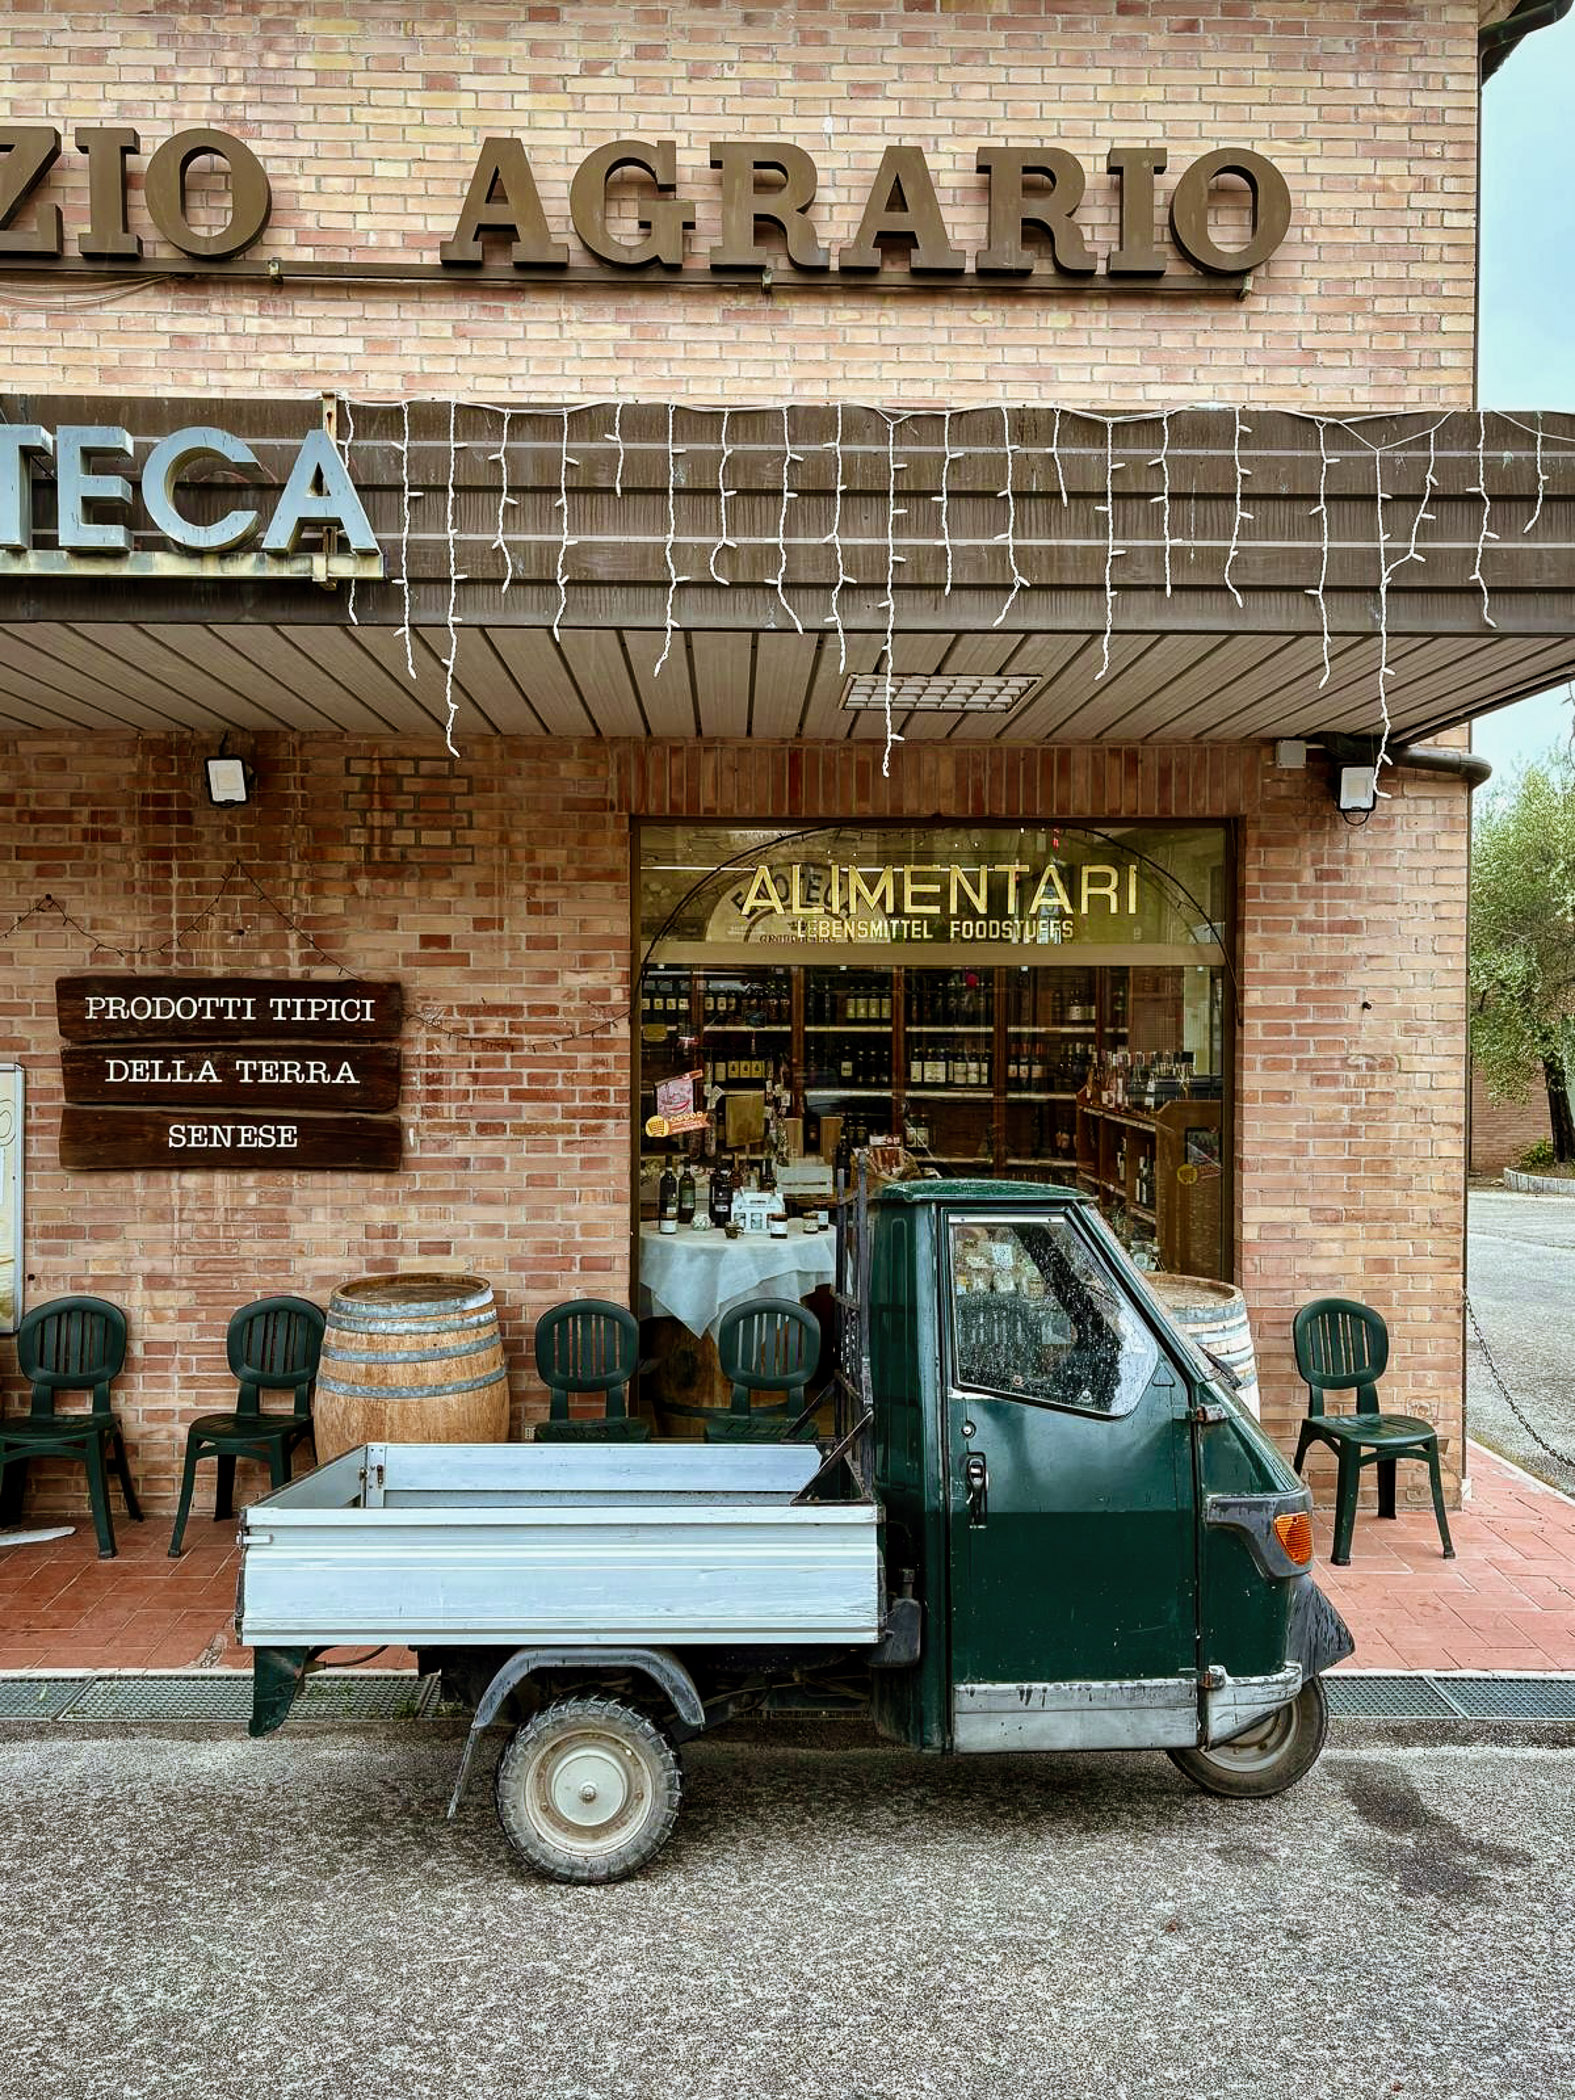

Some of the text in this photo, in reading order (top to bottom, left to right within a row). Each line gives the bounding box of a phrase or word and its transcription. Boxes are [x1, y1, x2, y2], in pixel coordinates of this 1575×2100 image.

[0, 127, 1292, 274] ZIO AGRARIO
[740, 863, 1138, 916] ALIMENTARI
[797, 919, 934, 940] LEBENSMITTEL
[949, 919, 1075, 940] FOODSTUFFS
[84, 996, 375, 1022] PRODOTTI TIPICI
[105, 1059, 360, 1085] DELLA TERRA
[168, 1124, 298, 1149] SENESE
